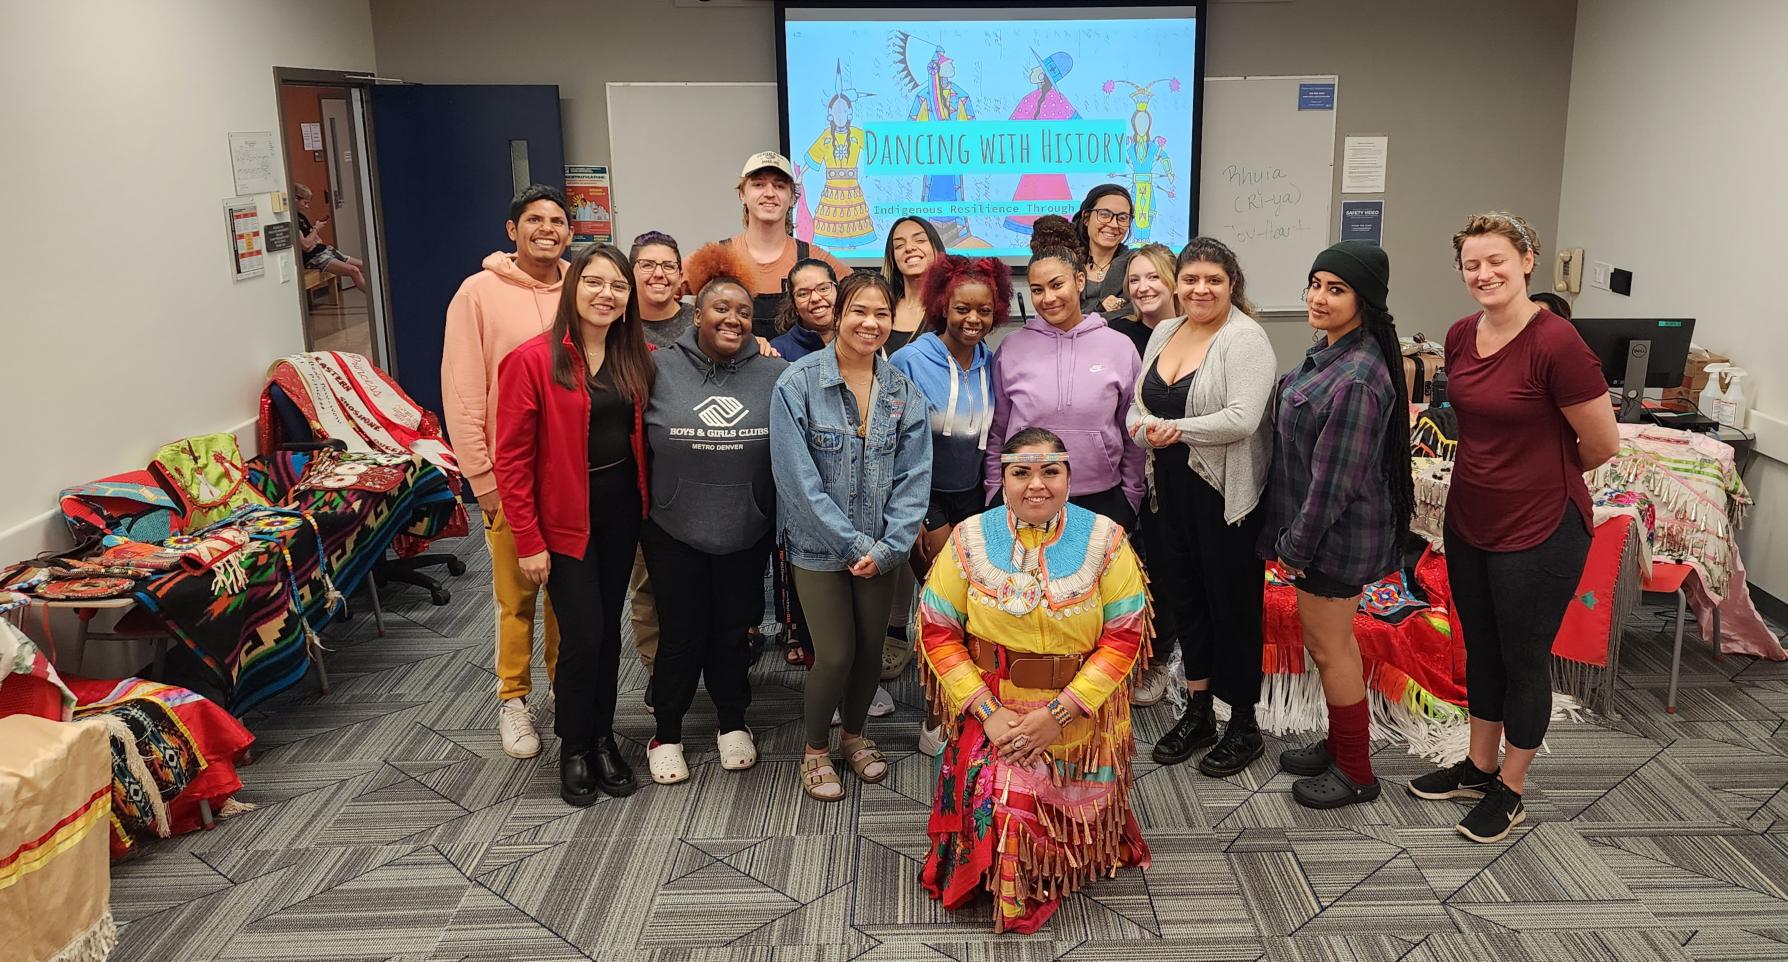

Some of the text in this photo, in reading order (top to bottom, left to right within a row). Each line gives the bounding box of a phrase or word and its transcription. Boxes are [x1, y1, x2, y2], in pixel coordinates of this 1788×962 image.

[873, 203, 1075, 216] Indigenous Resilience Through
[315, 356, 352, 392] EASTERN
[340, 396, 382, 432] SHOSHONE
[670, 427, 769, 438] BOYS & GIRLS CLUBS
[692, 443, 744, 451] METRO DENVER
